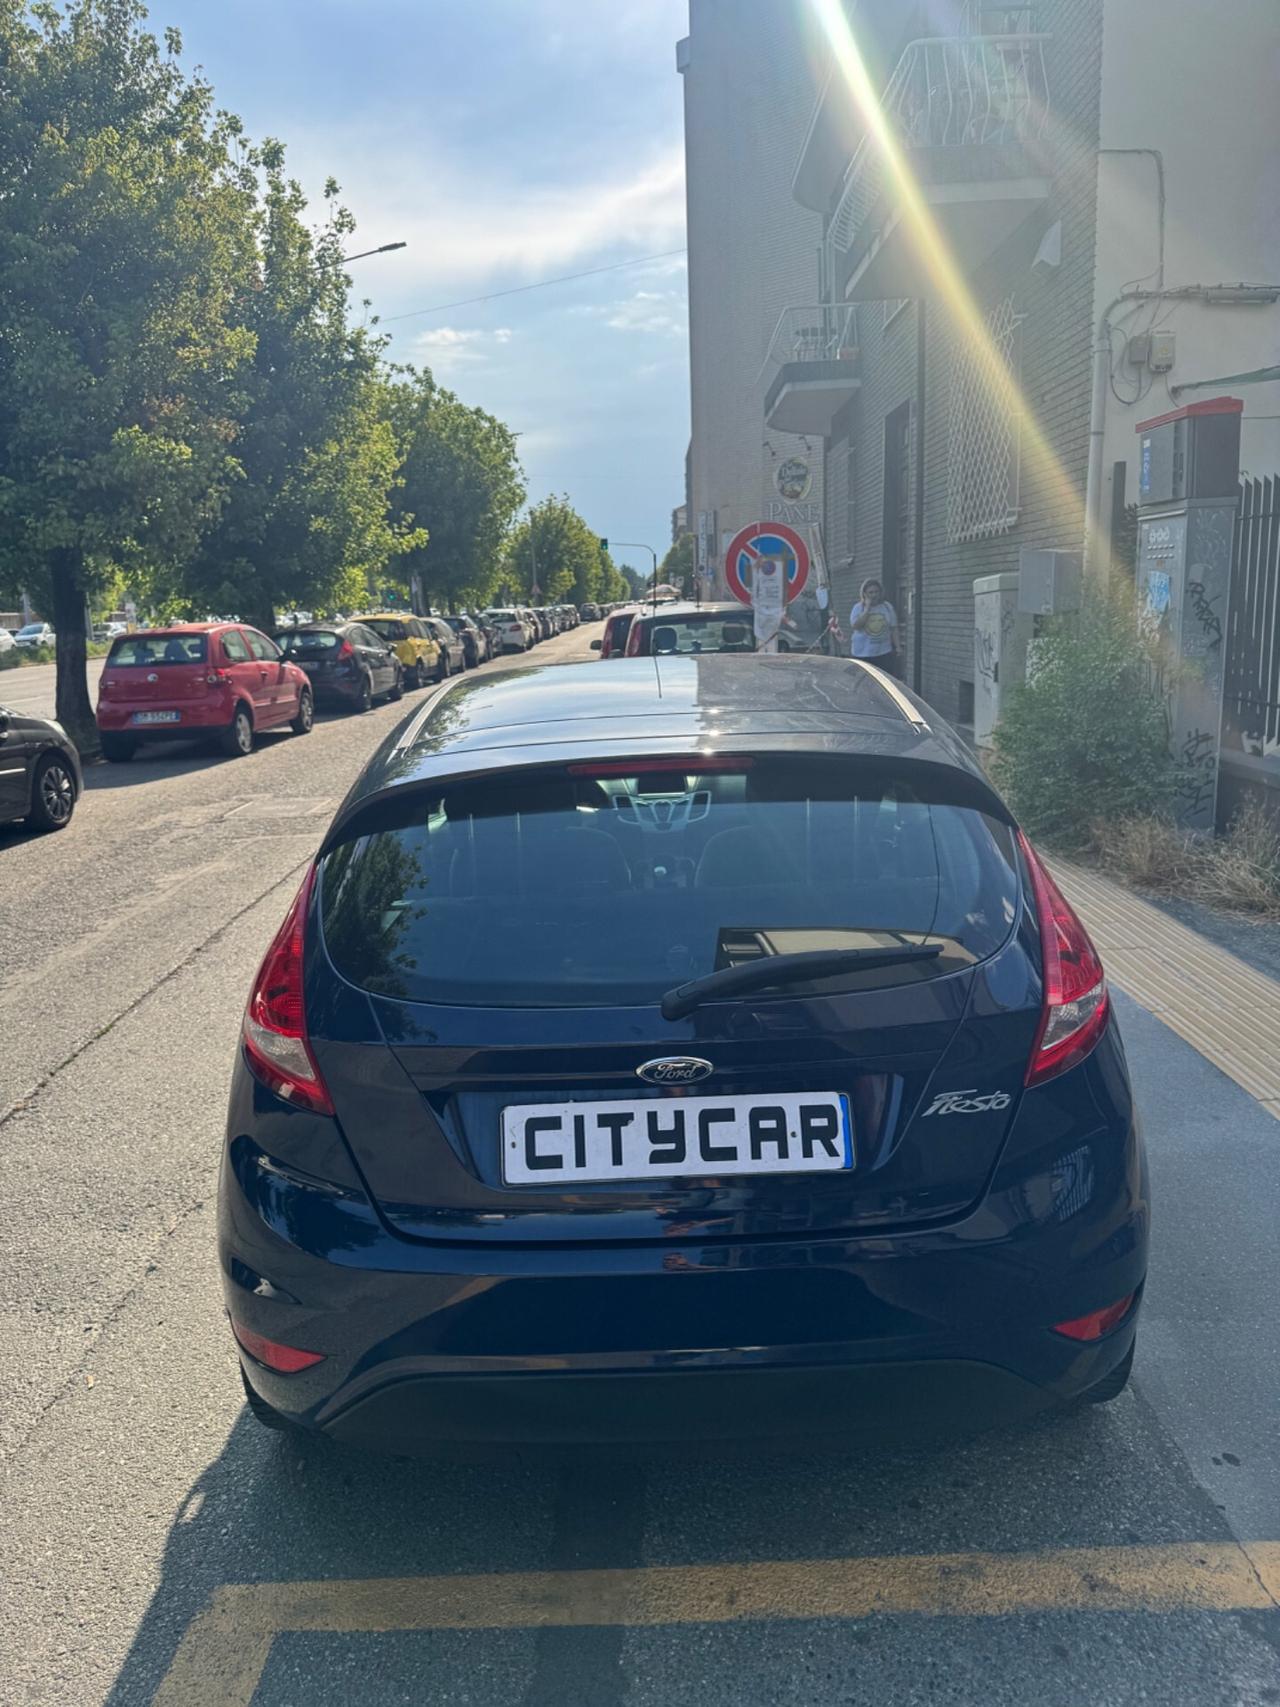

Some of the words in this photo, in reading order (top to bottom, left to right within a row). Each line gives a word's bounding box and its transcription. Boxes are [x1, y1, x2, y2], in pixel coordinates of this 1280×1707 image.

[769, 503, 819, 522] PANE
[654, 1062, 702, 1079] Ford
[921, 1089, 1011, 1117] Fiesta
[525, 1104, 840, 1170] CITYCAR
